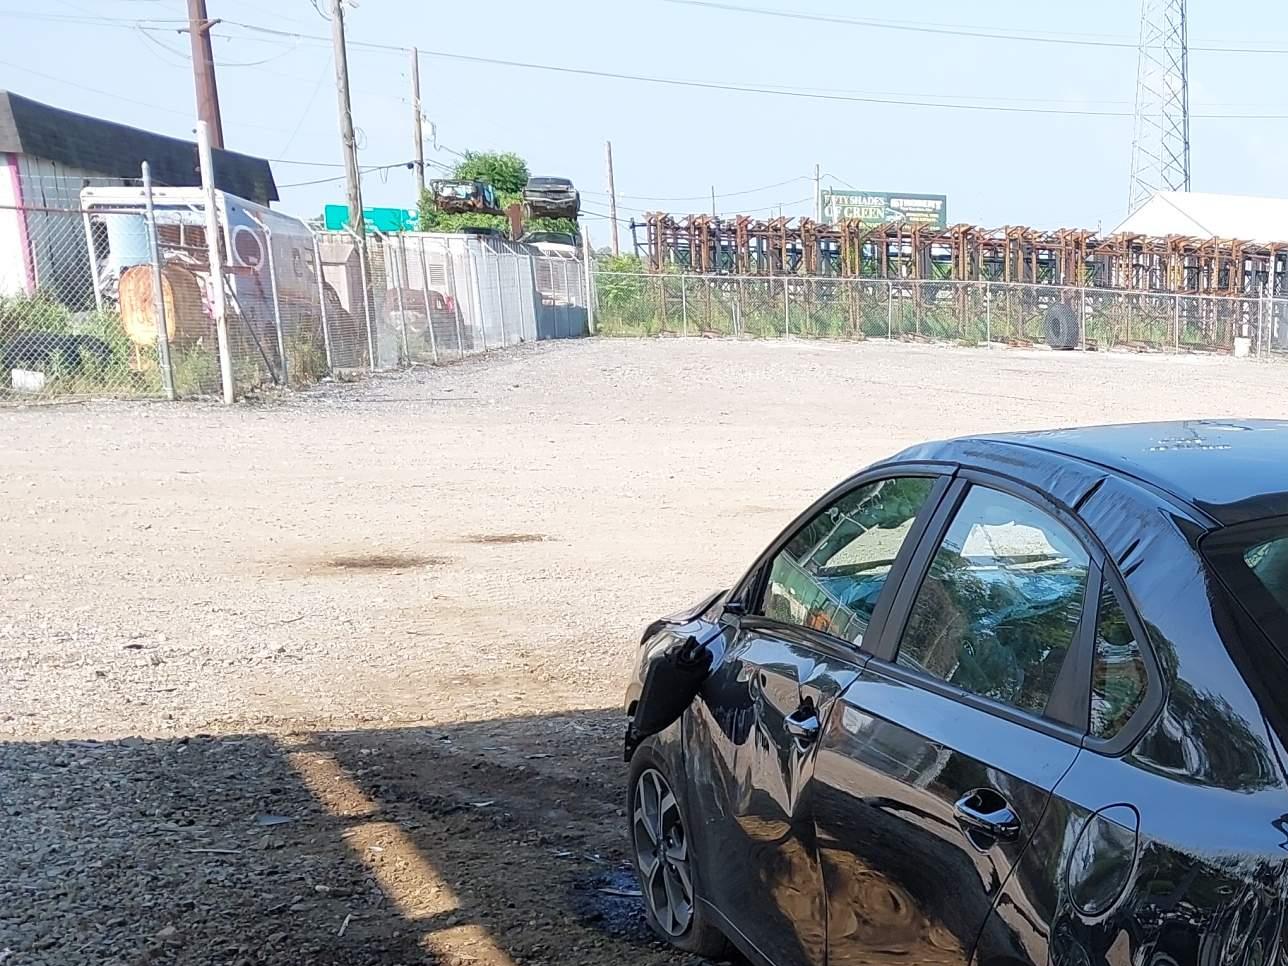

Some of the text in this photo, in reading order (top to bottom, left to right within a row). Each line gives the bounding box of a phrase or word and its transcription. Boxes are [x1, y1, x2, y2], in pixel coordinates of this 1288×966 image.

[849, 196, 885, 206] SHADES
[824, 206, 885, 219] OF GREEN
